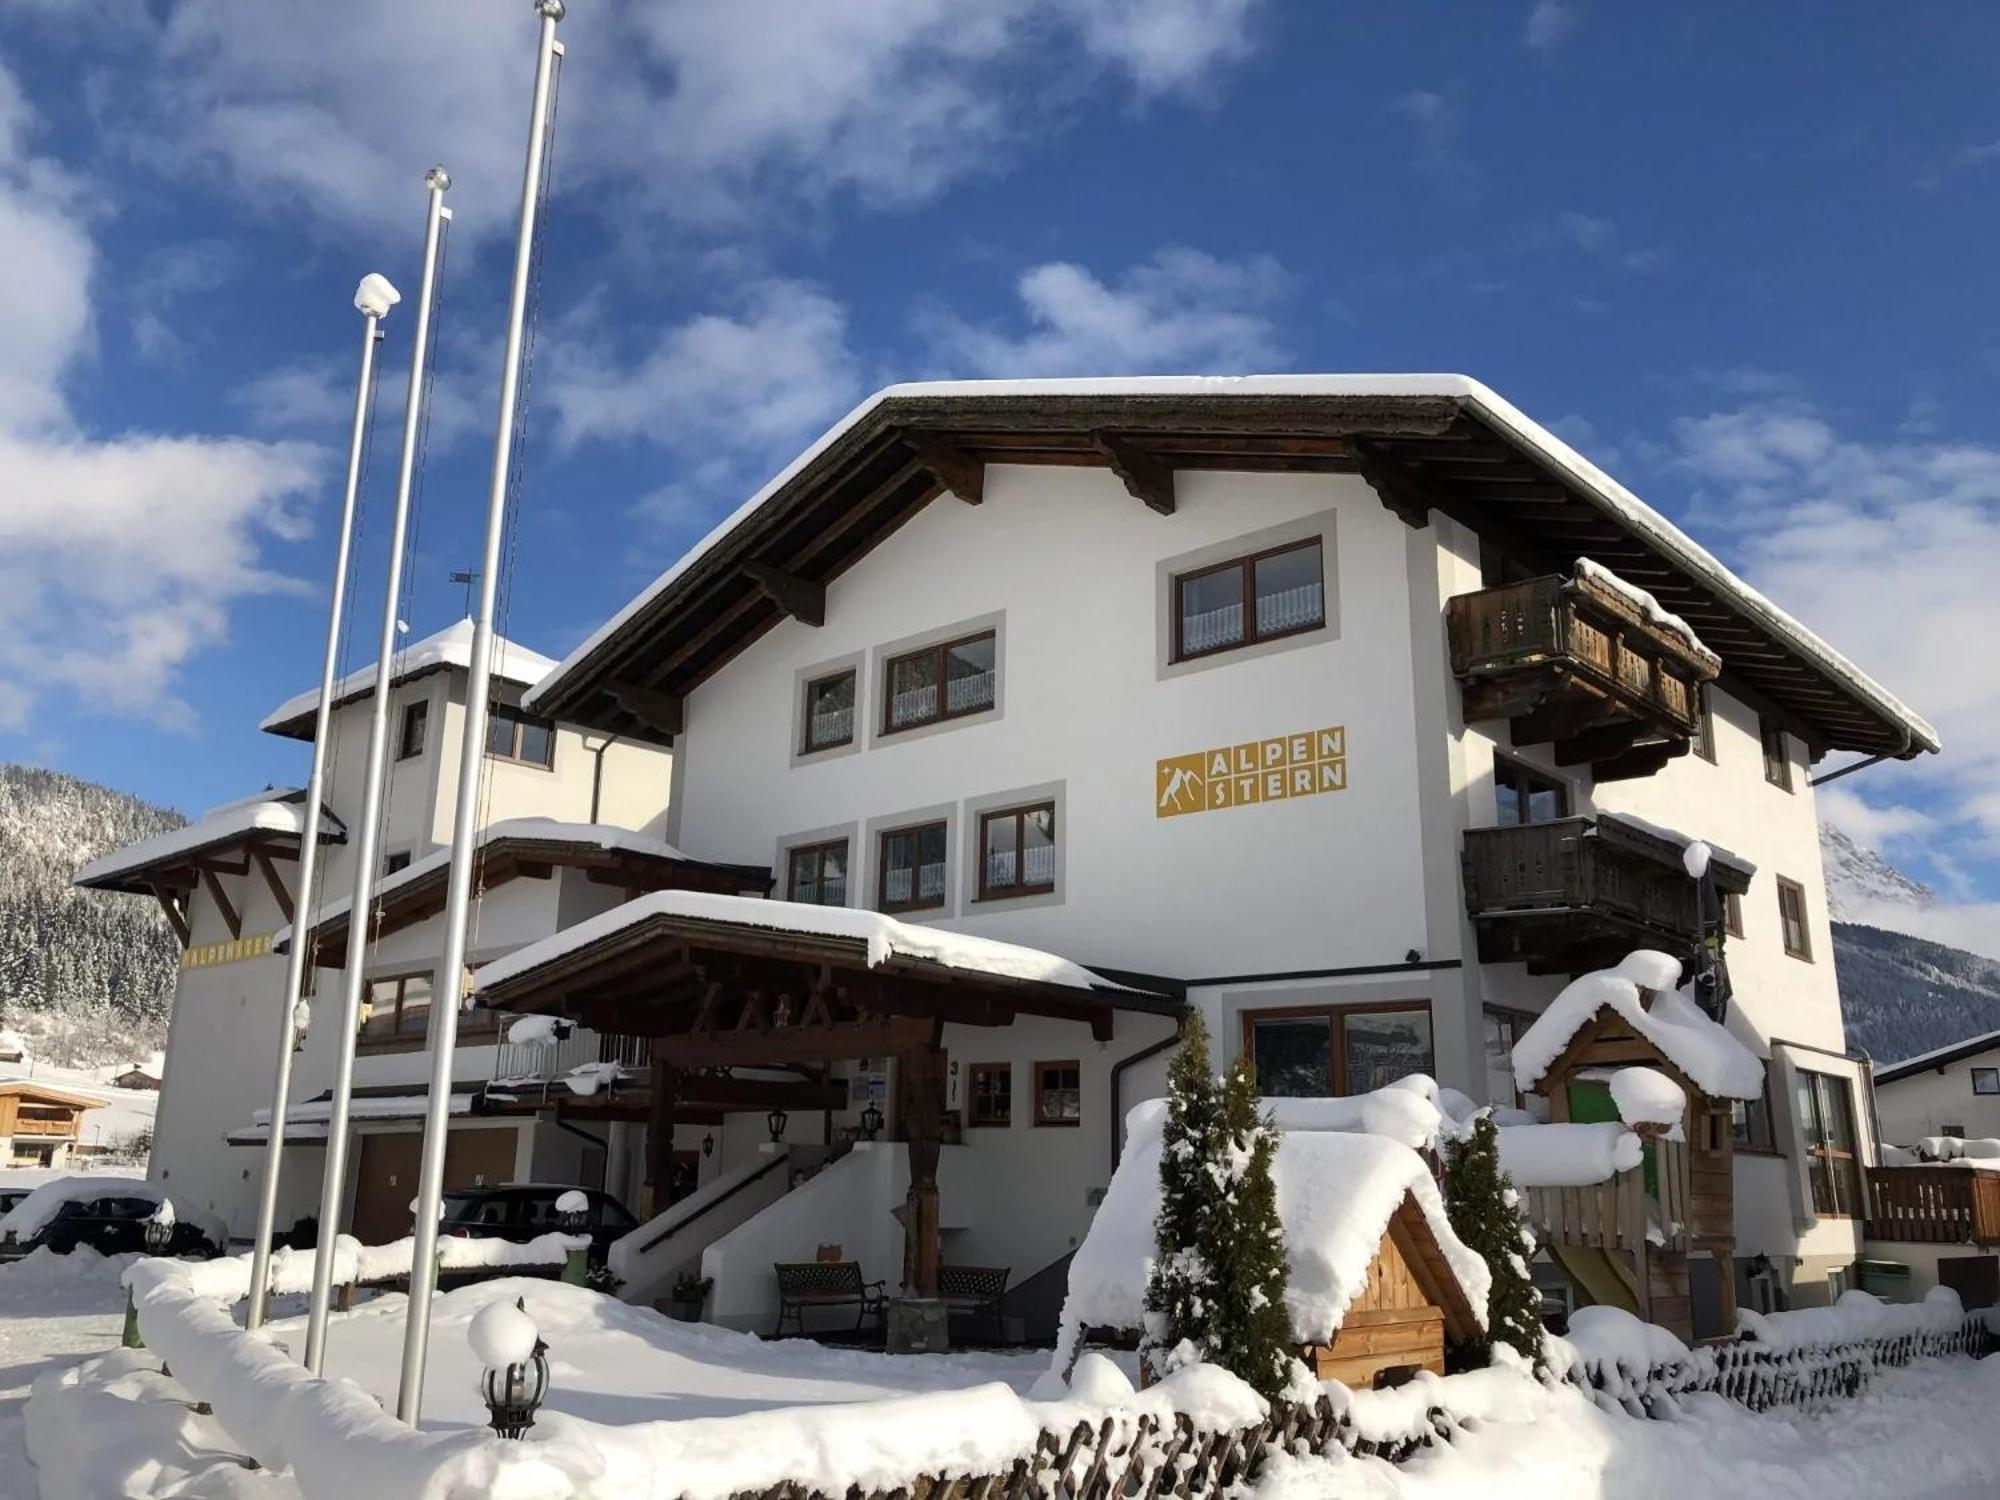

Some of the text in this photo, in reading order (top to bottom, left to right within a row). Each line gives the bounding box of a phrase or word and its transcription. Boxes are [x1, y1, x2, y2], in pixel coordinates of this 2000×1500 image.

[1210, 731, 1342, 776] ALPEN
[1214, 763, 1343, 805] STERN
[190, 935, 272, 967] ALPENSTER
